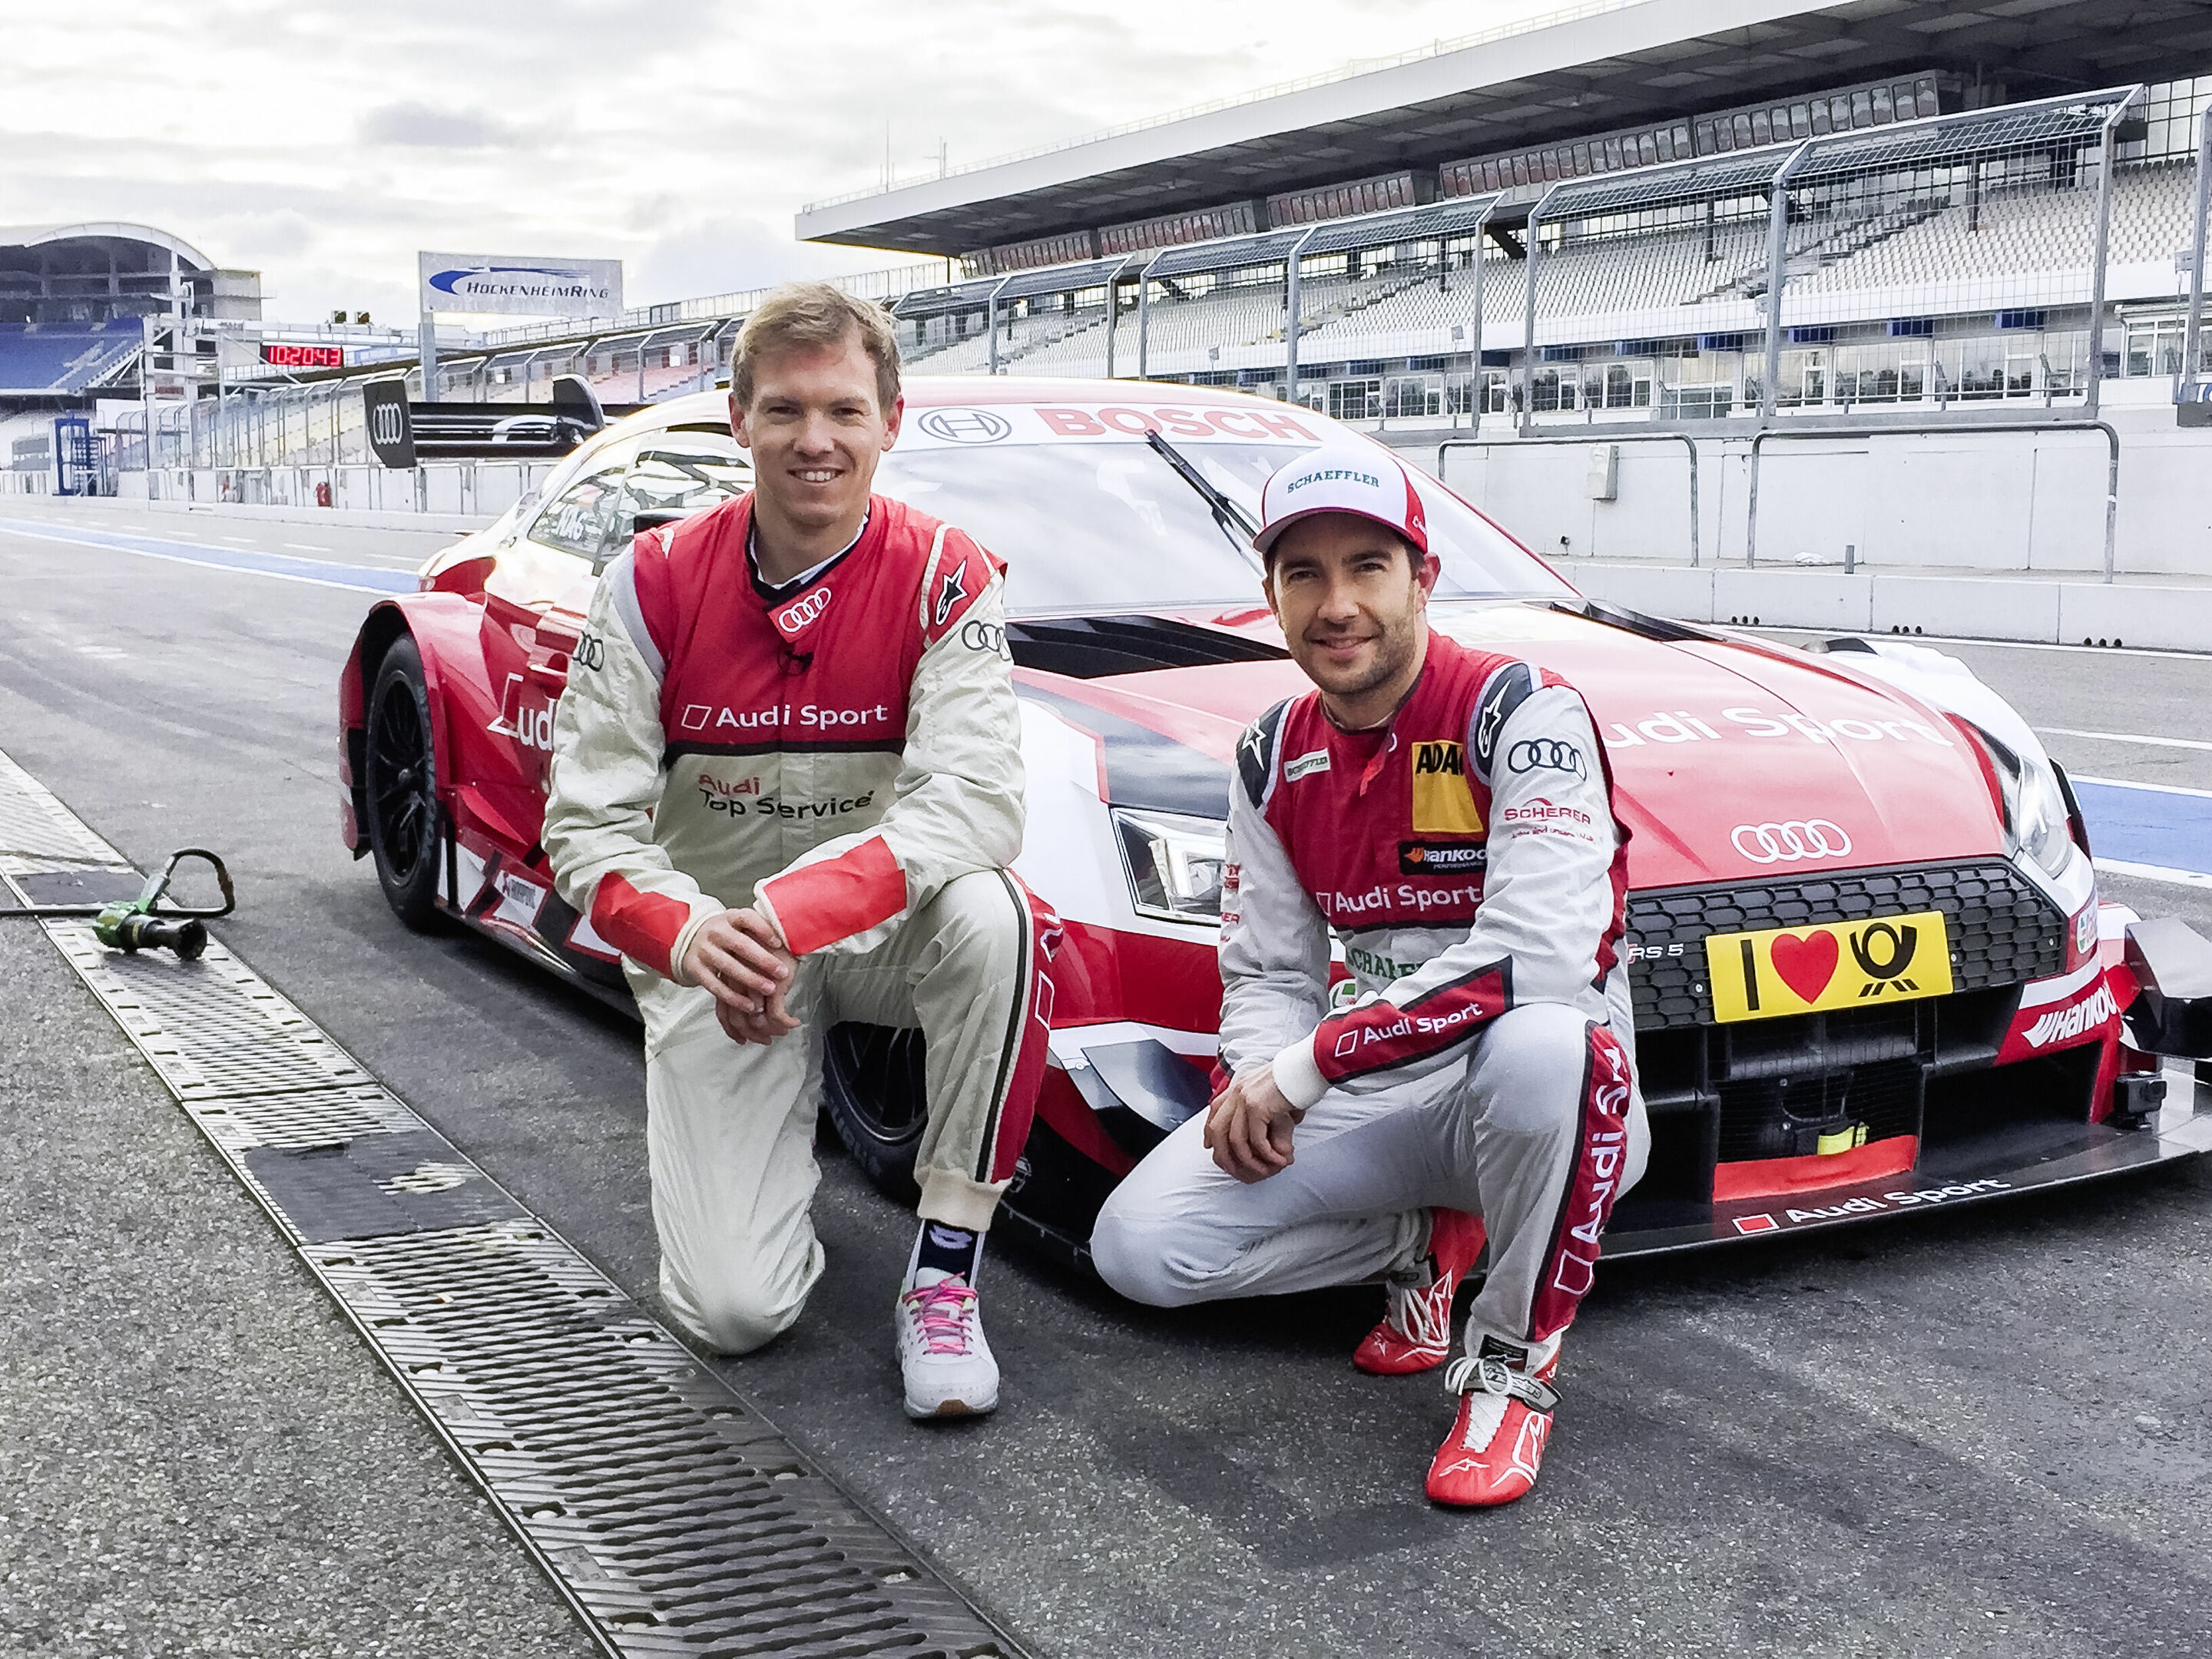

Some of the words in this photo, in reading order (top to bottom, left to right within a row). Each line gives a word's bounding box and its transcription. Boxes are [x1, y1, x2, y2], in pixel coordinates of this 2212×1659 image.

[270, 346, 341, 366] 10:20:43
[1034, 408, 1323, 442] BOSCH
[1287, 470, 1379, 493] SCHAEFFLER
[716, 704, 791, 727] Audi
[800, 704, 889, 730] Sport
[1602, 710, 1722, 749] udi
[1721, 707, 1955, 747] Sport
[1416, 743, 1464, 776] ADA
[698, 774, 760, 796] Audi
[699, 788, 746, 818] Top
[1505, 806, 1591, 824] SCHERER
[1424, 849, 1488, 863] Hankoo
[1336, 886, 1392, 912] Audi
[1397, 884, 1483, 912] Sport
[1667, 943, 1684, 956] 5
[1740, 939, 1760, 1012] I
[1363, 1017, 1412, 1045] Audi
[1416, 1003, 1483, 1034] Sport
[1571, 1131, 1624, 1244] Audi
[1786, 1197, 1888, 1223] Audi
[1883, 1179, 2012, 1205] Sport
